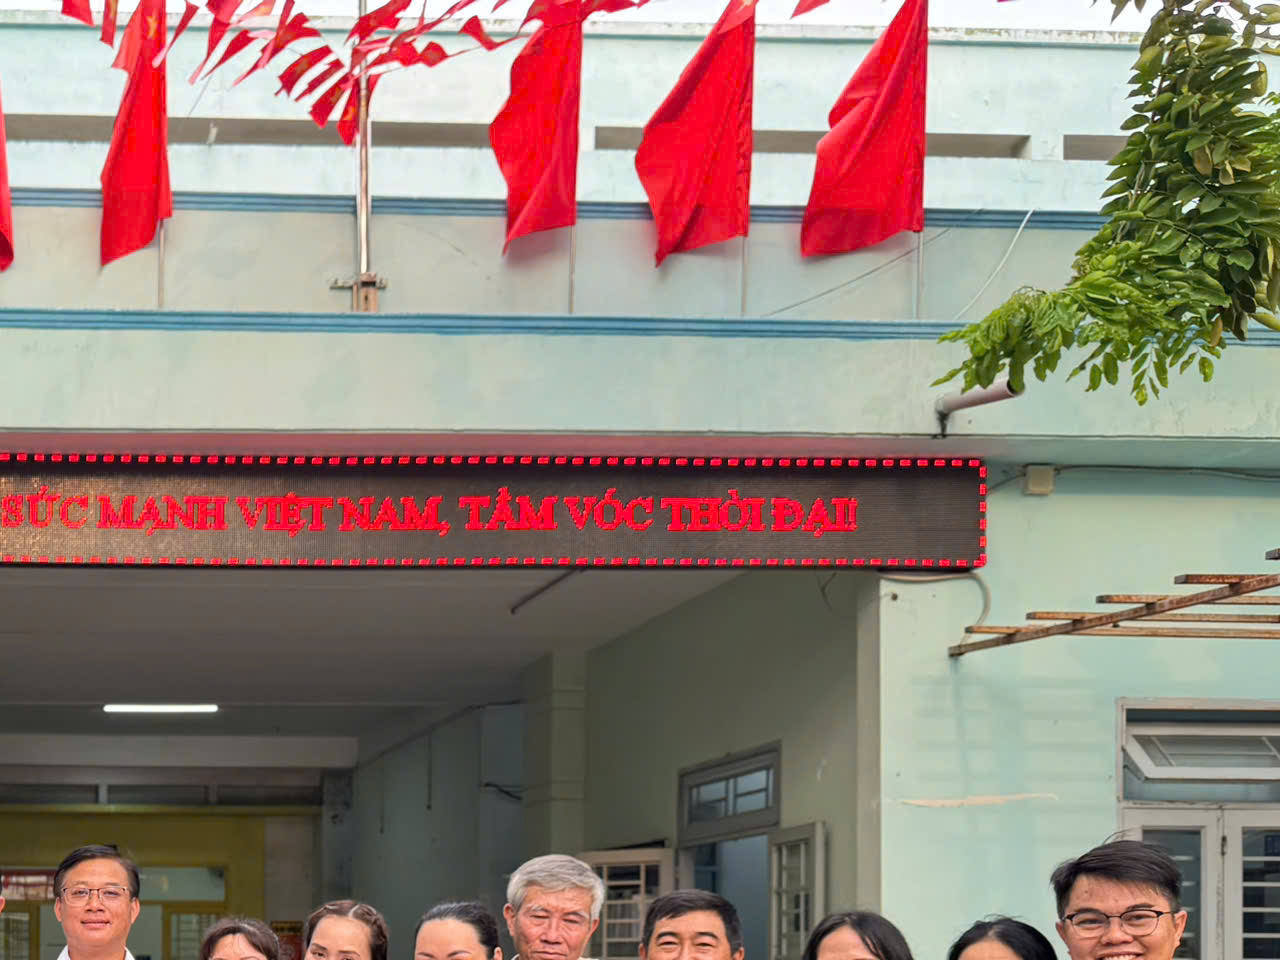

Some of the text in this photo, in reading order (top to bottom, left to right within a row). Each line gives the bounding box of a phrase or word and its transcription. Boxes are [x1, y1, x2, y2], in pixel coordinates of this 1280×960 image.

[0, 485, 89, 529] SỨC
[96, 495, 229, 537] MẠNH
[235, 491, 333, 538] VIỆT
[336, 495, 451, 537] NAM,
[563, 487, 655, 532] VÓC
[660, 488, 766, 532] THỜI
